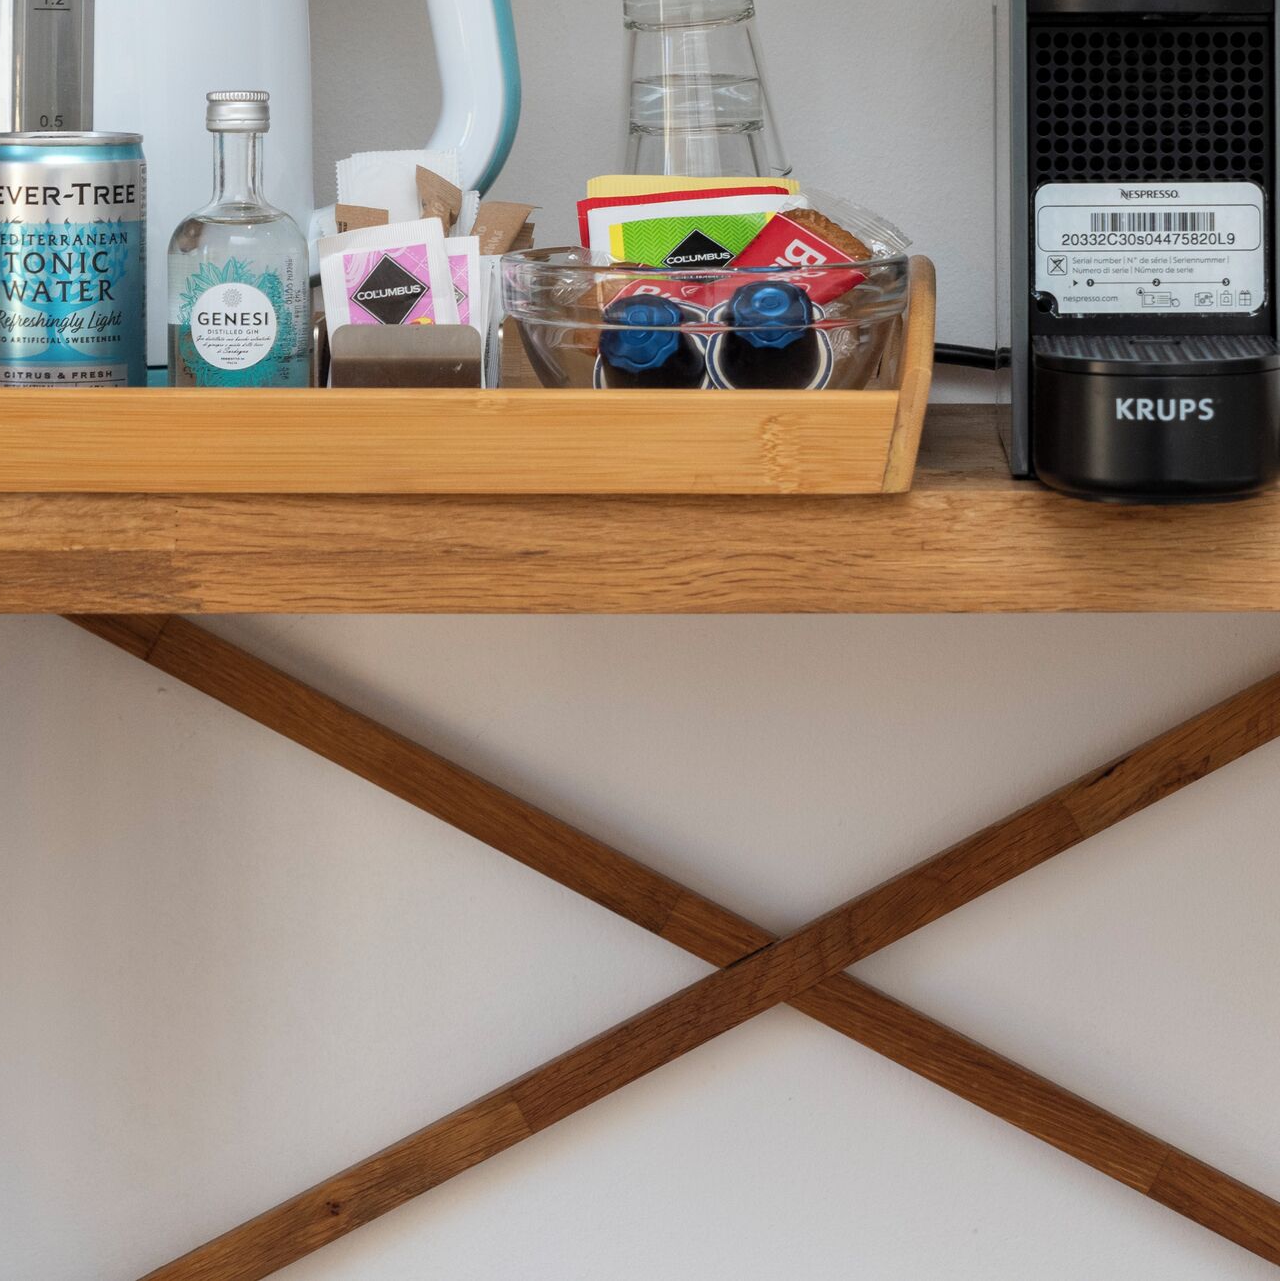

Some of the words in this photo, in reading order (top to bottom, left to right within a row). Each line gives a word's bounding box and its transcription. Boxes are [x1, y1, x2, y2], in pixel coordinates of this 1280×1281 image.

[39, 115, 64, 128] 0.5
[1120, 189, 1179, 200] NESPRESSO
[1061, 232, 1236, 246] 20332C30s04475820L9
[4, 251, 109, 274] TONIC
[666, 251, 731, 266] COLUMBUS
[1072, 256, 1092, 264] Serial
[1139, 256, 1149, 264] de
[1172, 256, 1226, 264] Seriennummer
[1103, 266, 1110, 274] di
[1112, 266, 1129, 274] serie
[1165, 266, 1175, 274] de
[1176, 266, 1193, 274] serie
[2, 280, 115, 302] WATER
[356, 284, 421, 301] COLUMBUS
[1063, 295, 1118, 304] nespresso.com
[87, 310, 122, 333] Light
[197, 311, 269, 326] GENESI
[10, 335, 61, 344] ARTIFICIAL
[4, 371, 51, 379] CITRUS
[57, 371, 65, 379] &
[71, 370, 113, 379] FRESH
[1115, 397, 1215, 422] KRUPS
